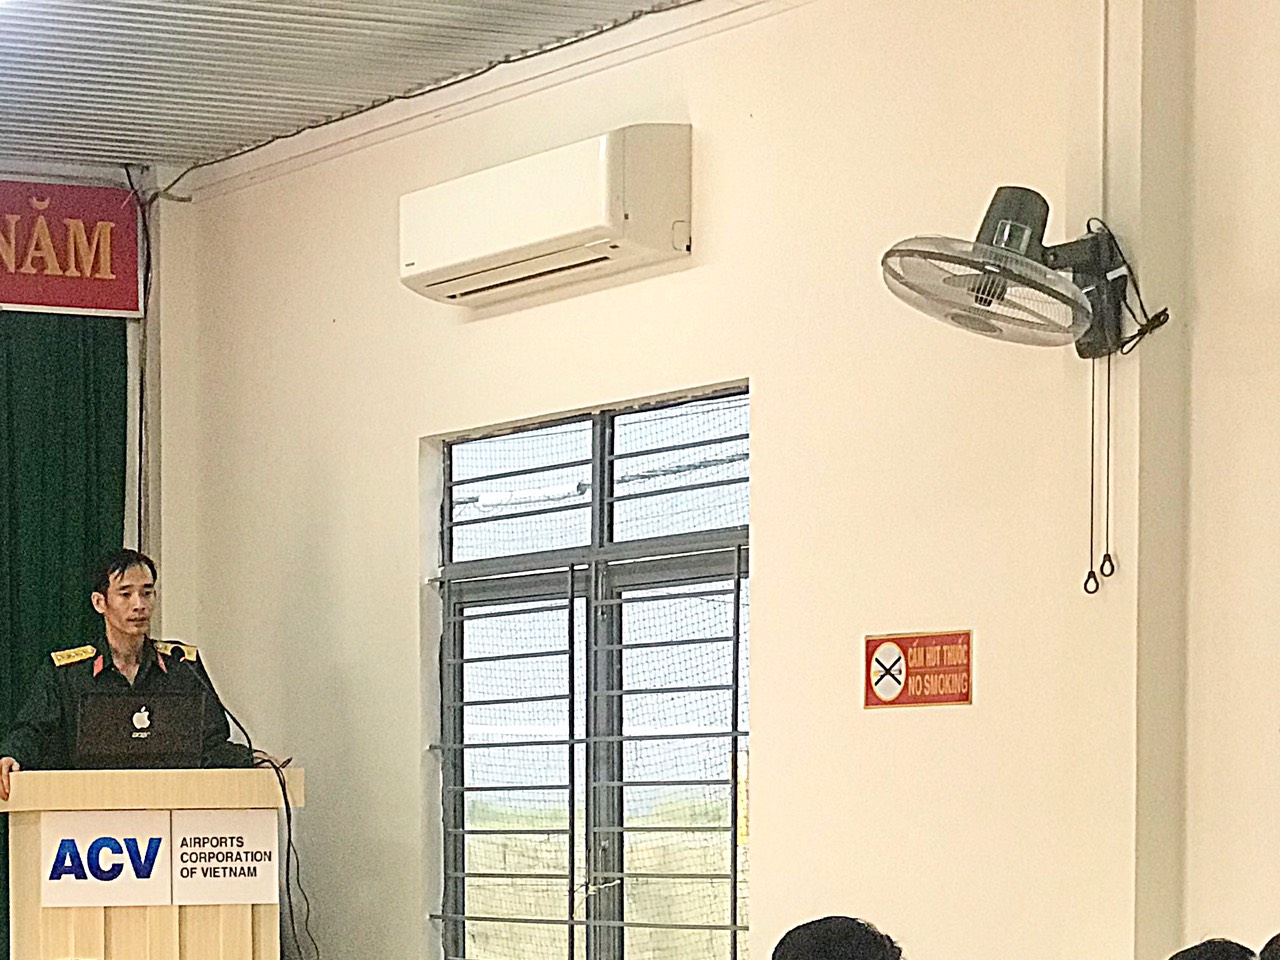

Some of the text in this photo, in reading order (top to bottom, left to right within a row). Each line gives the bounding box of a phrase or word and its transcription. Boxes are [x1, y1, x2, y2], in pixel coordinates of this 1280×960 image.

[908, 672, 969, 696] NO SMOKING
[179, 836, 244, 848] AIRPORTS
[48, 837, 162, 881] ACV
[179, 850, 272, 863] CORPORATION
[179, 866, 258, 879] OF VIETNAM
